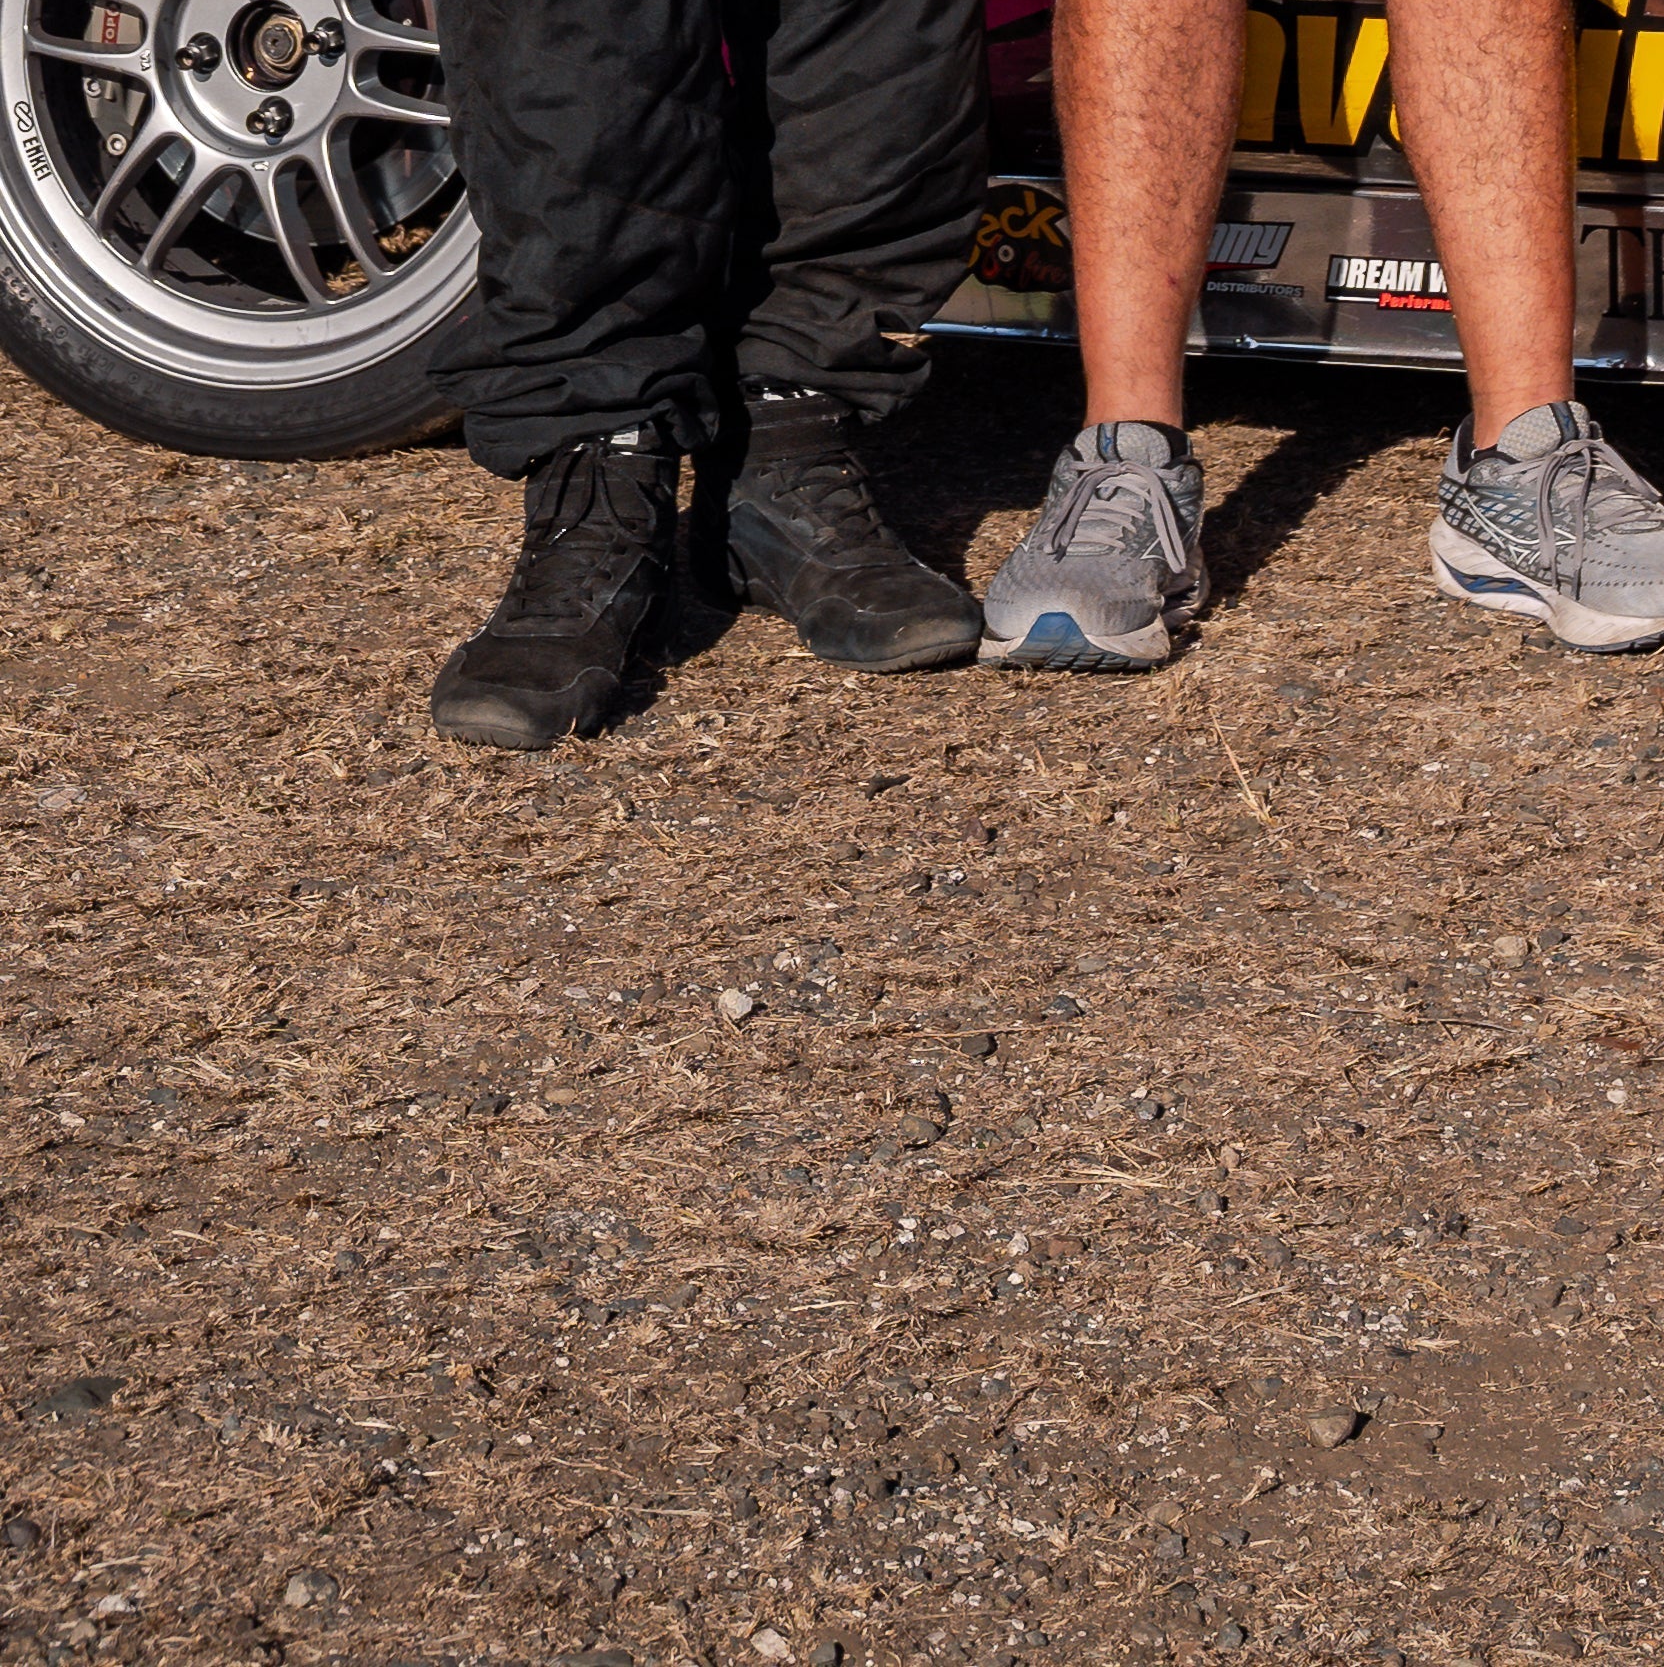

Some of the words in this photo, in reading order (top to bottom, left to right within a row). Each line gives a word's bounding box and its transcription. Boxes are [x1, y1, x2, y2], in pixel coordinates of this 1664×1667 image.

[22, 136, 52, 182] ENKEI
[1206, 279, 1304, 299] DISTRIBUTORS
[1327, 256, 1426, 292] DREAM
